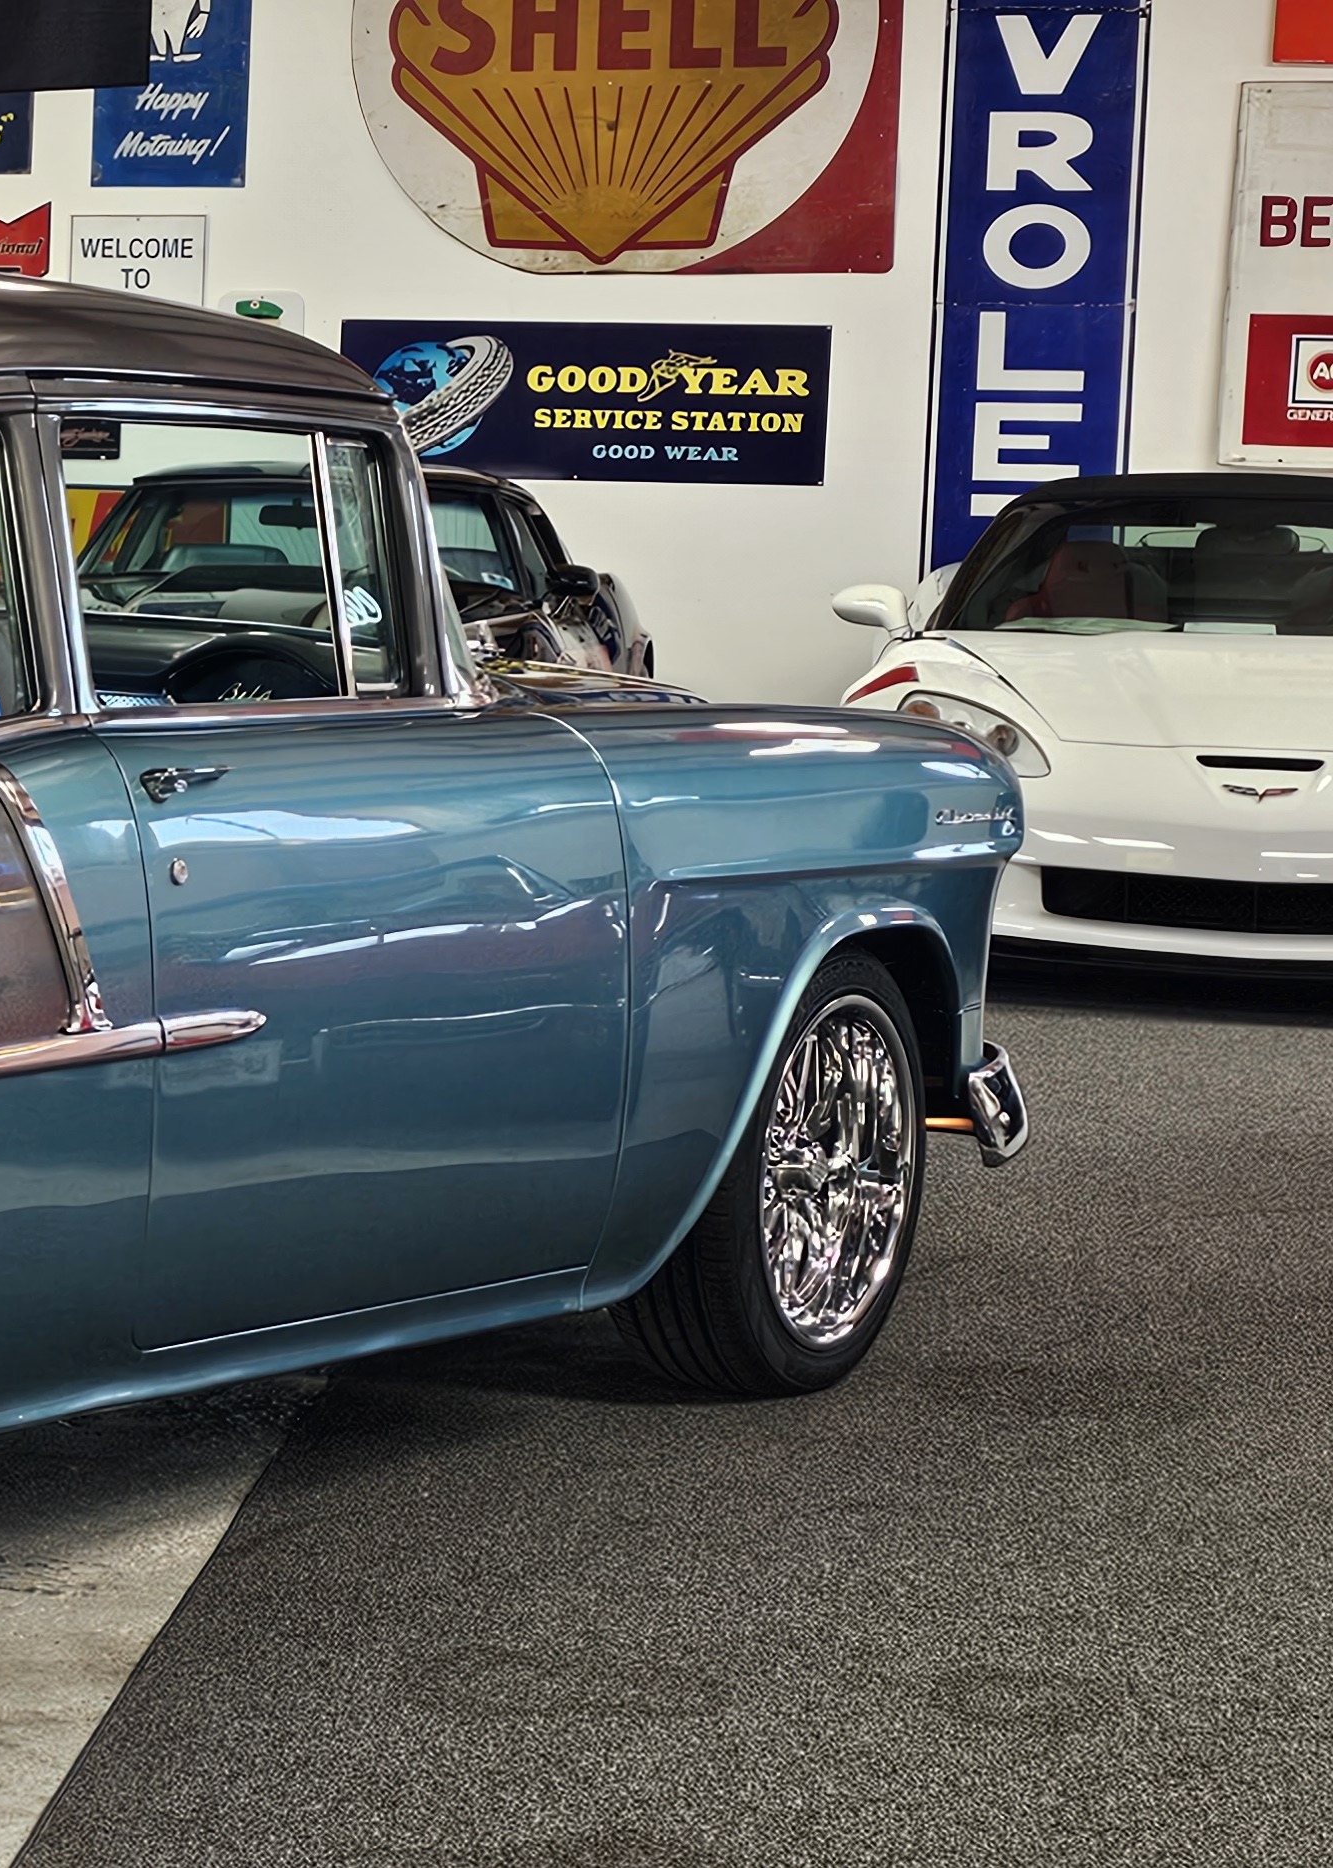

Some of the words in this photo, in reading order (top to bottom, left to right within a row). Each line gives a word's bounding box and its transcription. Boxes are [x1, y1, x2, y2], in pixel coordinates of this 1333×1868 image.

[430, 0, 788, 76] SHELL
[135, 83, 209, 120] Happy
[113, 126, 230, 165] Motoring!
[81, 238, 194, 259] WELCOME
[121, 268, 150, 289] TO
[970, 15, 1103, 517] VROLE
[1313, 361, 1333, 380] A
[534, 408, 662, 430] SERVICE
[671, 411, 804, 433] STATION
[592, 444, 655, 459] GOOD
[664, 446, 738, 461] WEAR
